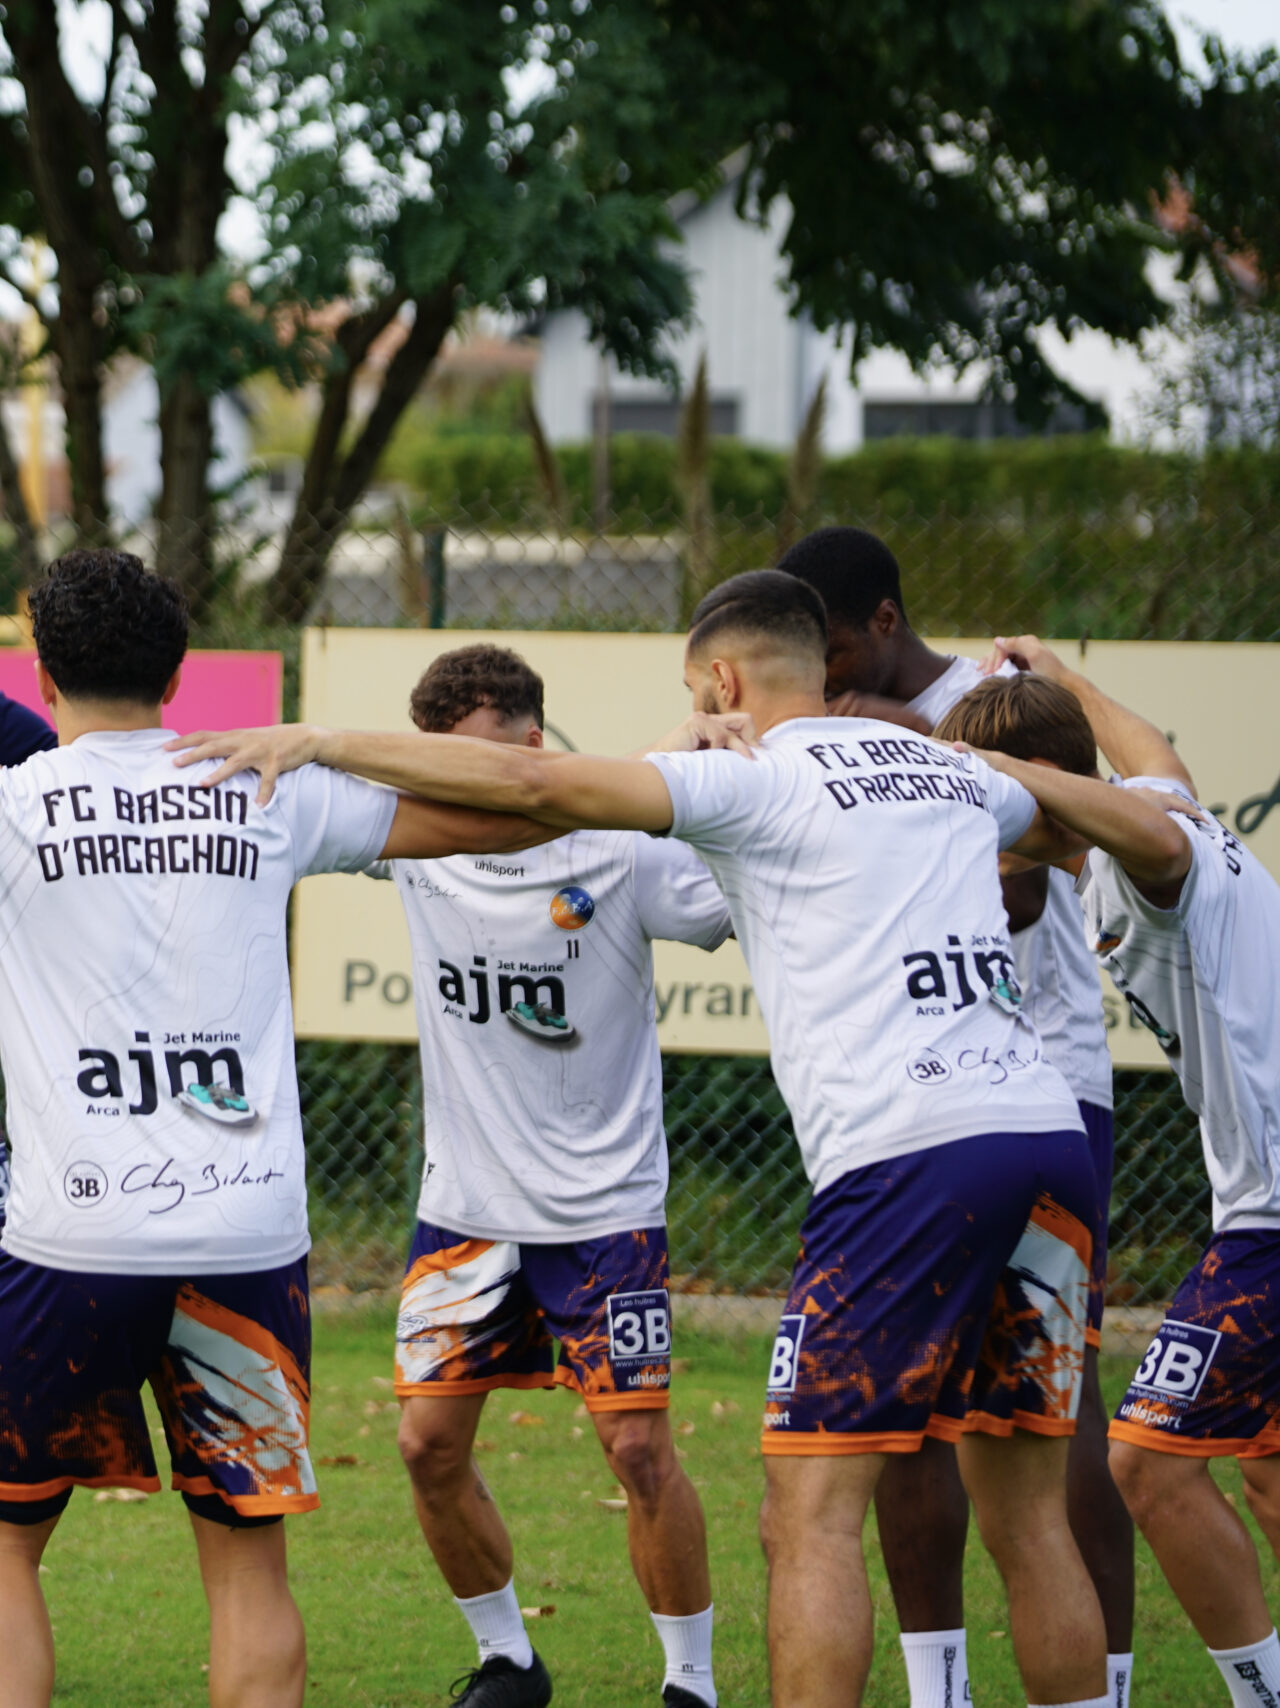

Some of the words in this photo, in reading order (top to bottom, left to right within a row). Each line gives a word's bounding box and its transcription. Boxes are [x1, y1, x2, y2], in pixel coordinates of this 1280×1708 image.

[806, 742, 861, 771] FC
[42, 784, 97, 828] FC
[113, 784, 248, 826] BASSIN
[37, 833, 260, 883] D'ARCACHON
[474, 860, 526, 878] uhlsport
[497, 959, 516, 970] Jet
[519, 962, 565, 973] Marine
[438, 954, 566, 1025] ajm
[915, 1005, 946, 1017] Arca
[163, 1032, 187, 1045] Jet
[191, 1031, 241, 1044] Marine
[76, 1031, 246, 1116] ajm
[914, 1060, 947, 1080] 3B
[85, 1104, 121, 1117] Arca
[70, 1177, 101, 1198] 3B
[614, 1307, 671, 1355] 3B
[1134, 1337, 1203, 1393] 3B
[763, 1410, 791, 1428] port
[1120, 1402, 1183, 1430] uhlsport
